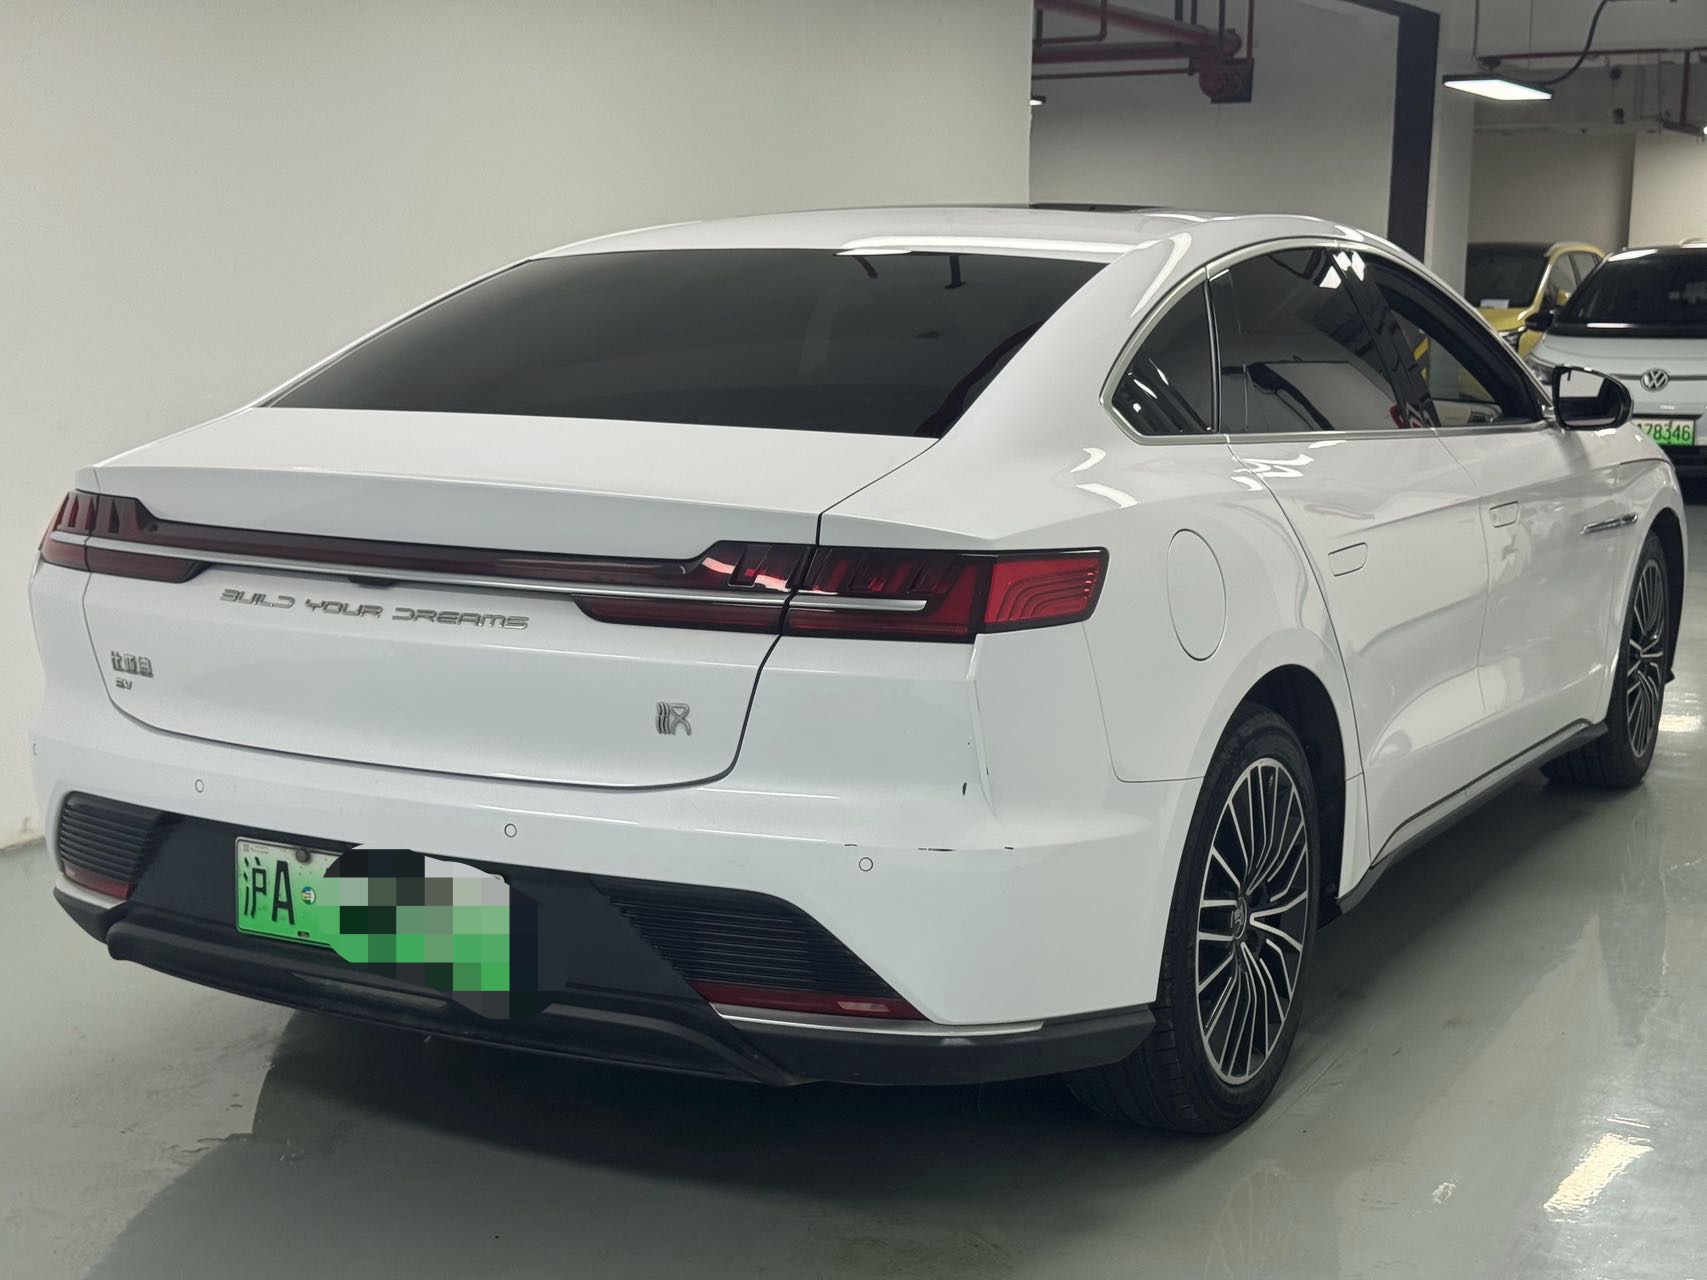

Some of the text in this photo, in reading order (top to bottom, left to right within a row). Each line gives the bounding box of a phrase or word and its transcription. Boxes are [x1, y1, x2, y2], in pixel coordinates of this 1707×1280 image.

[1637, 423, 1691, 441] 78346
[220, 588, 529, 630] BUILD YOUR DREAMS
